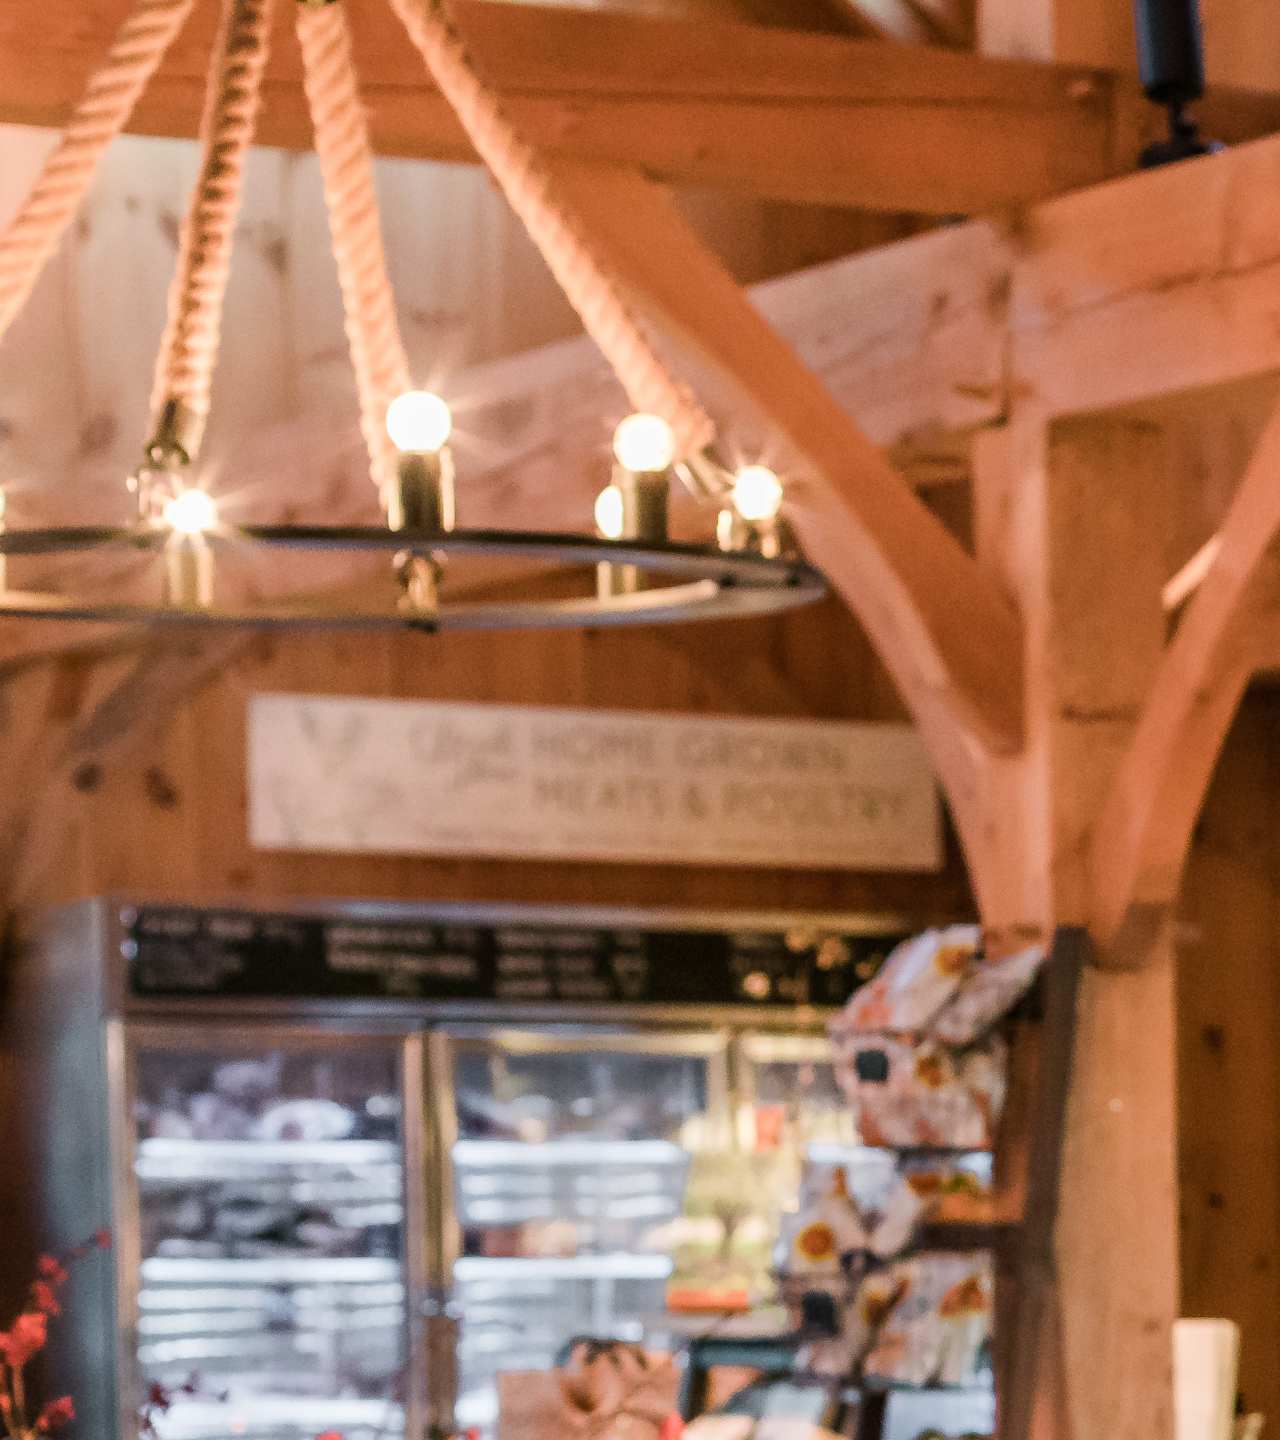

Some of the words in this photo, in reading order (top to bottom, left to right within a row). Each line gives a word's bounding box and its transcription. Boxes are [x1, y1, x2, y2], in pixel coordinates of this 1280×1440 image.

[531, 729, 655, 768] HOME
[533, 776, 667, 820] MEATS
[721, 779, 907, 824] POULTRY
